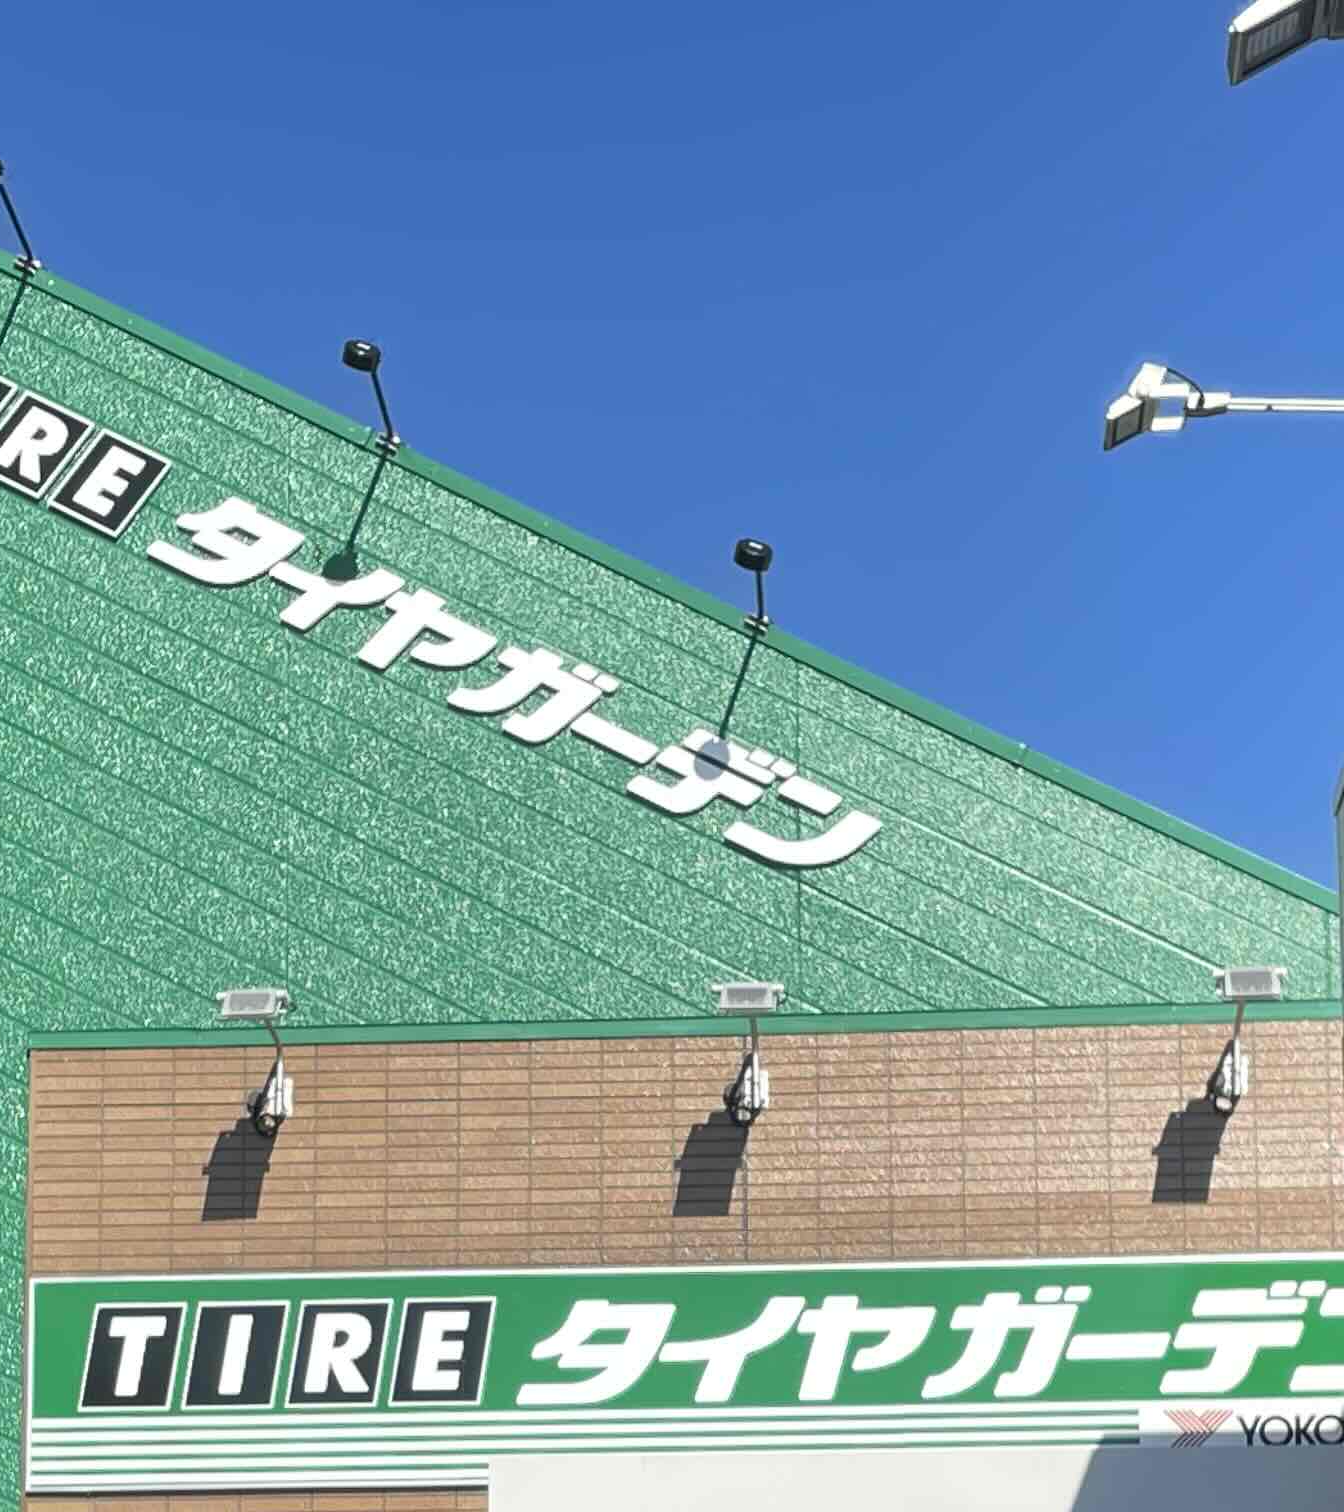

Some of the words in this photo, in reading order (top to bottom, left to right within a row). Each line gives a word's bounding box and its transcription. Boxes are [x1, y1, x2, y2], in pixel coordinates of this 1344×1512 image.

[146, 495, 884, 868] タイヤガーデン
[106, 1309, 472, 1399] TIRE
